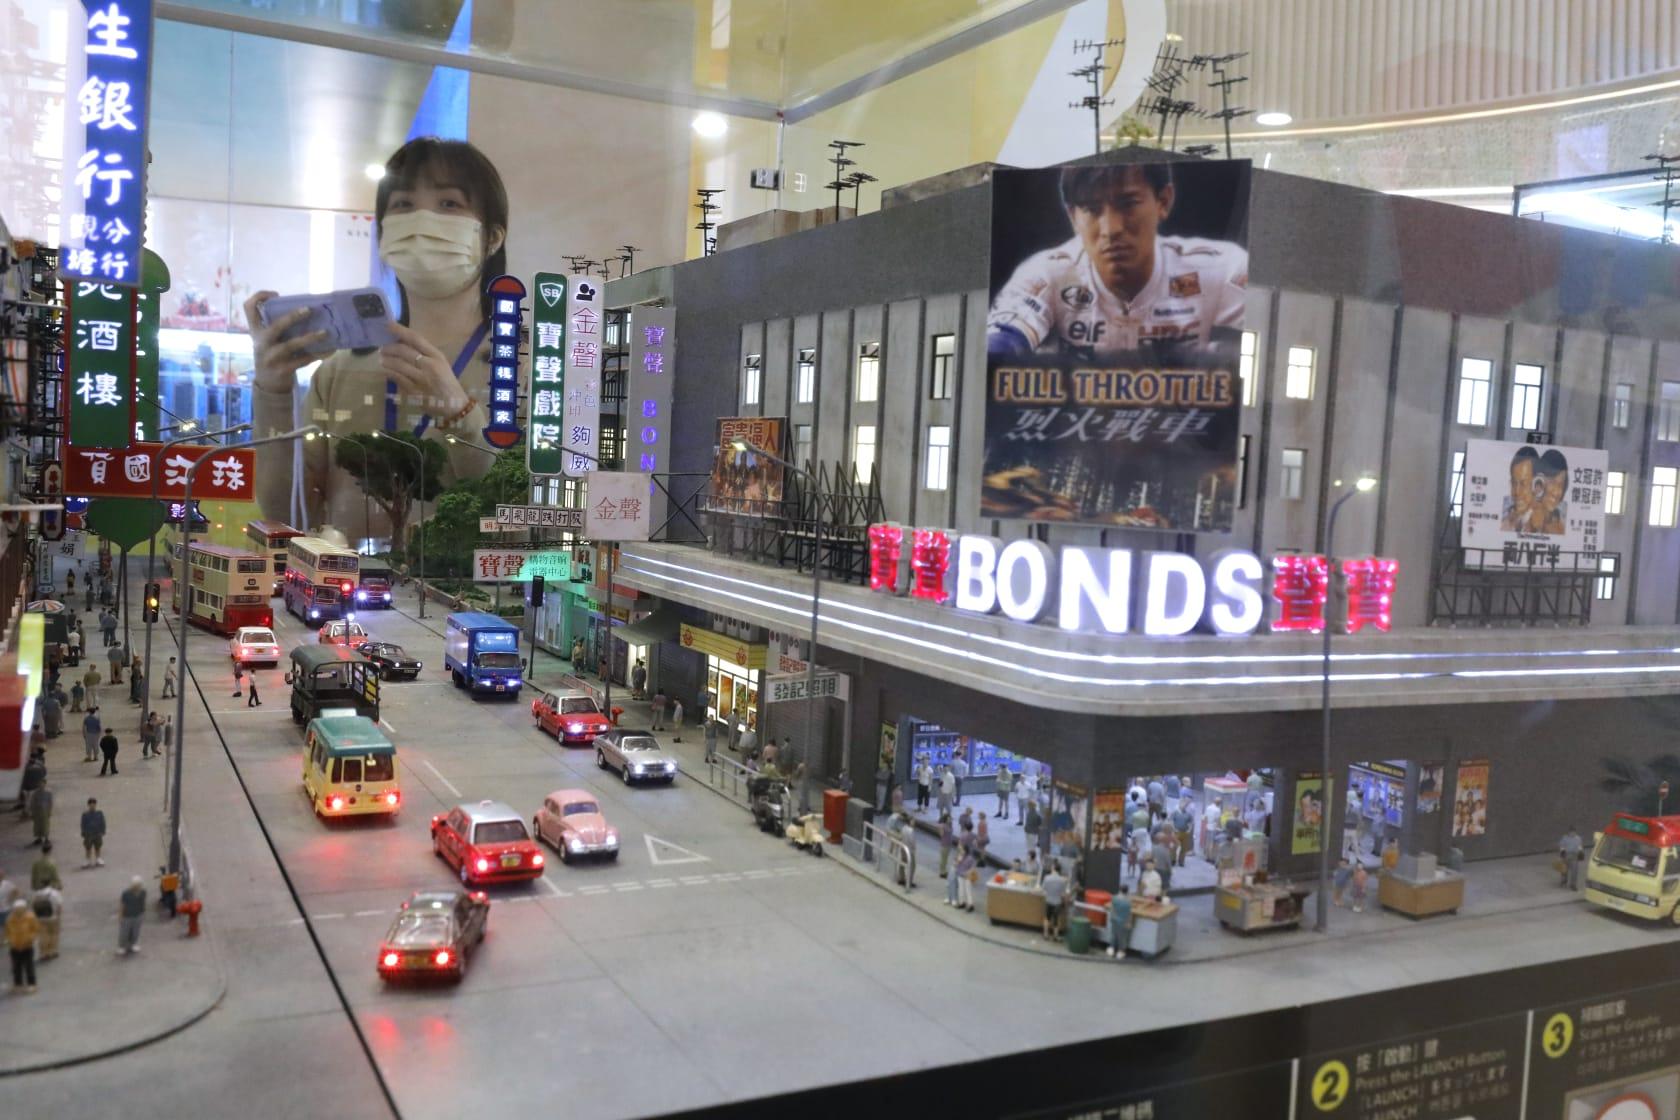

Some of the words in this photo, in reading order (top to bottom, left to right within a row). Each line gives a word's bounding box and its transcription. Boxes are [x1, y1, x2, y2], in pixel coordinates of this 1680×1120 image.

[996, 367, 1065, 401] FULL
[1072, 369, 1232, 405] THROTTLE
[594, 496, 642, 522] 金聲
[956, 535, 1264, 636] BONDS
[1549, 1020, 1566, 1052] 3
[1320, 1071, 1340, 1105] 2
